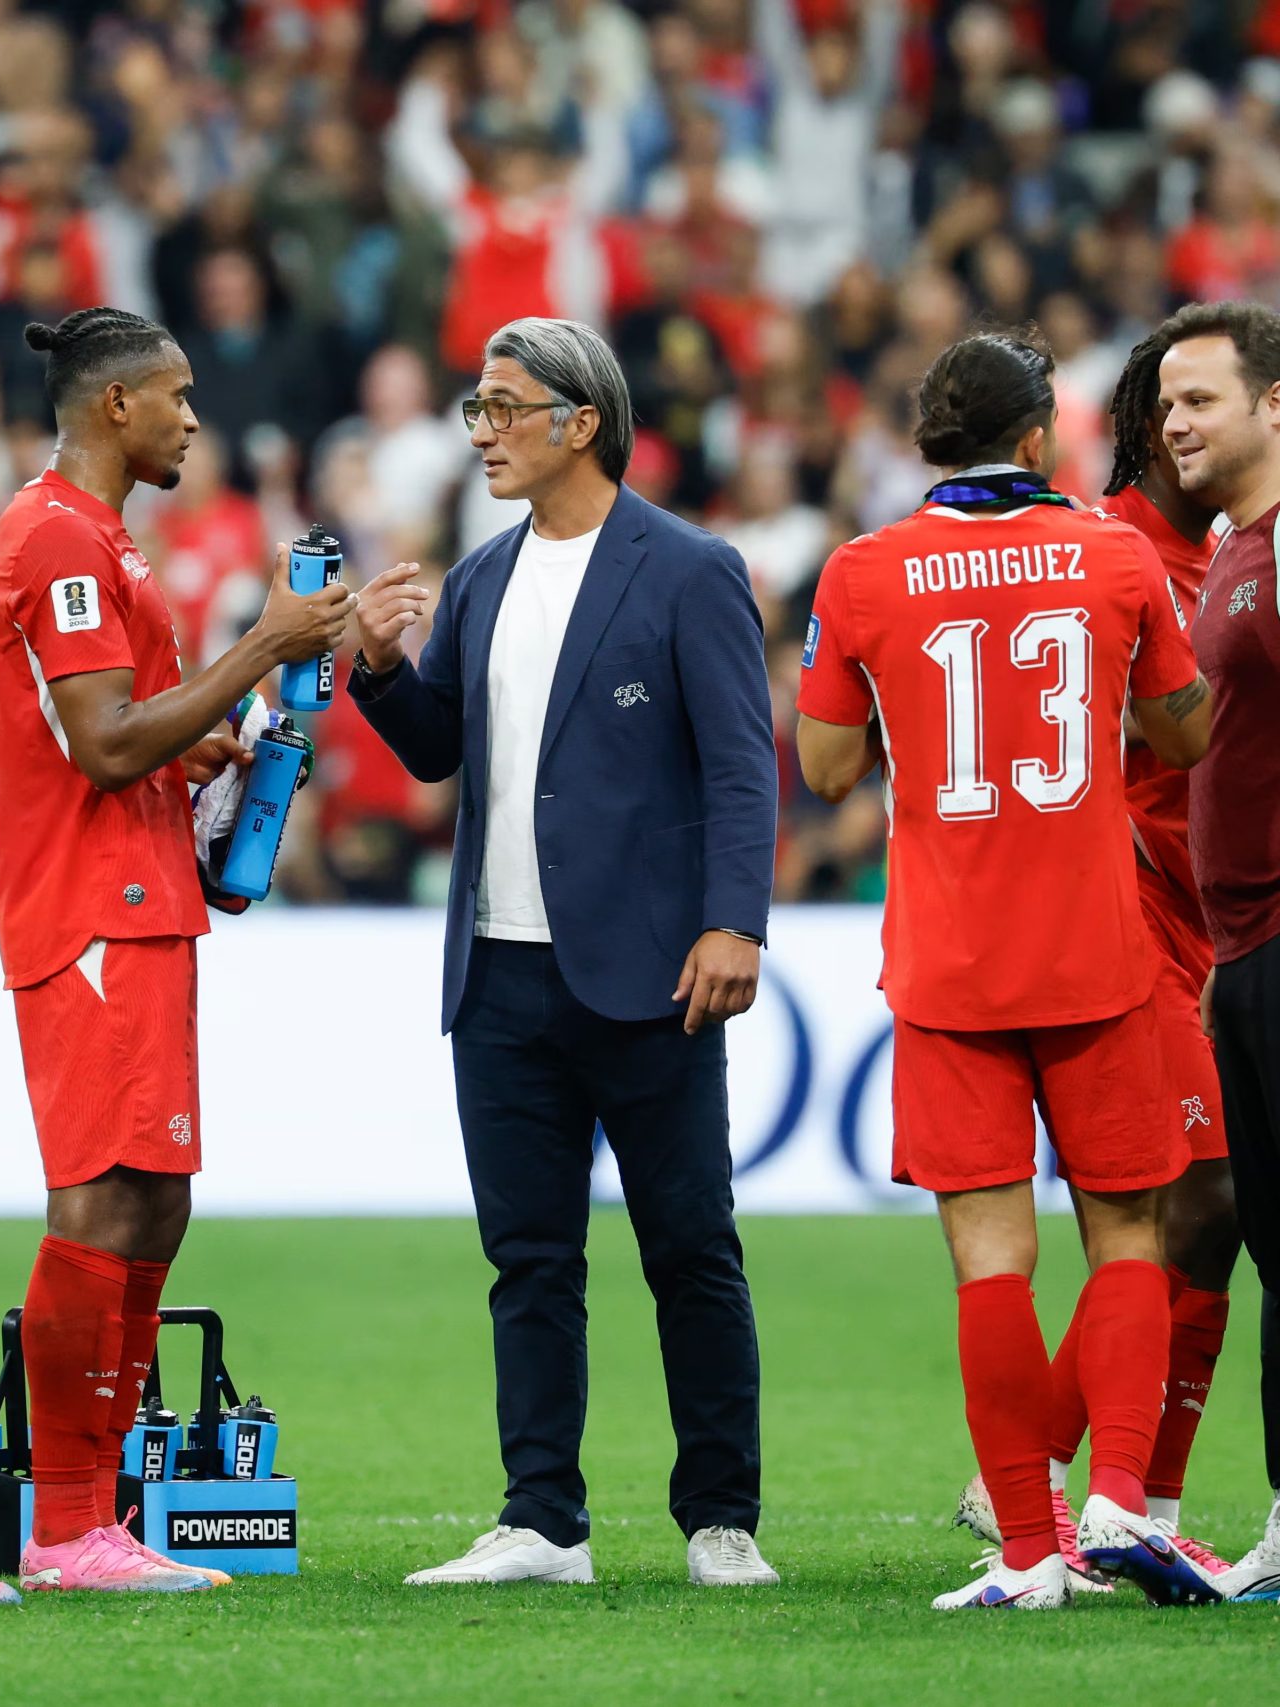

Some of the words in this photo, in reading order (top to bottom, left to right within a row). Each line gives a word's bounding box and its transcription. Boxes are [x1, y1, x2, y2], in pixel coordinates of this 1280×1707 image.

[294, 561, 302, 571] 9
[904, 543, 1086, 596] RODRIGUEZ
[920, 607, 1094, 822] 13
[268, 750, 285, 762] 22
[250, 797, 278, 812] POWER
[260, 807, 277, 818] ADE
[173, 1517, 291, 1542] POWERADE
